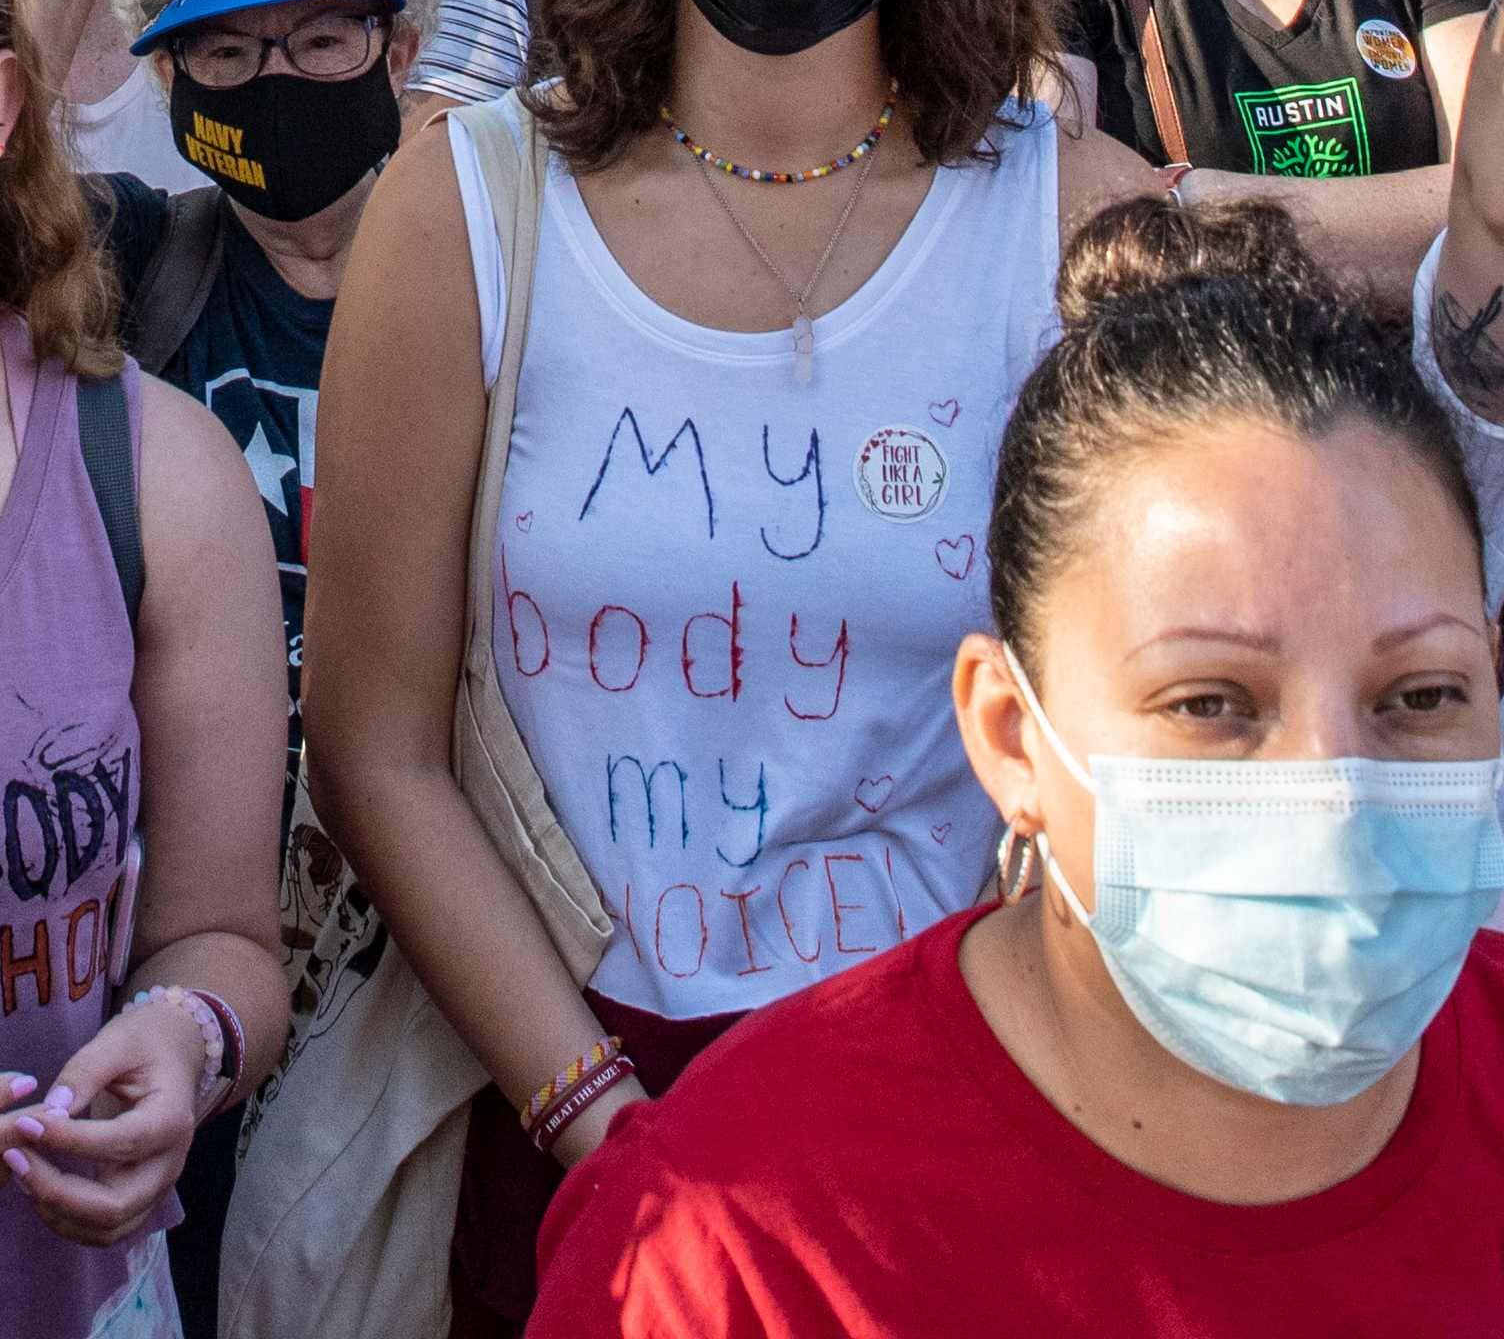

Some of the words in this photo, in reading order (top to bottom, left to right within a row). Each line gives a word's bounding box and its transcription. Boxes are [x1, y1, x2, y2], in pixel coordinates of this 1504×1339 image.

[1255, 94, 1345, 128] AUSTIN
[192, 110, 245, 156] NAVY
[881, 444, 921, 464] FIGHT
[881, 463, 908, 483] LIKE
[912, 464, 924, 484] A
[881, 483, 924, 507] GIRL
[501, 542, 849, 722] body
[572, 1083, 596, 1106] THE
